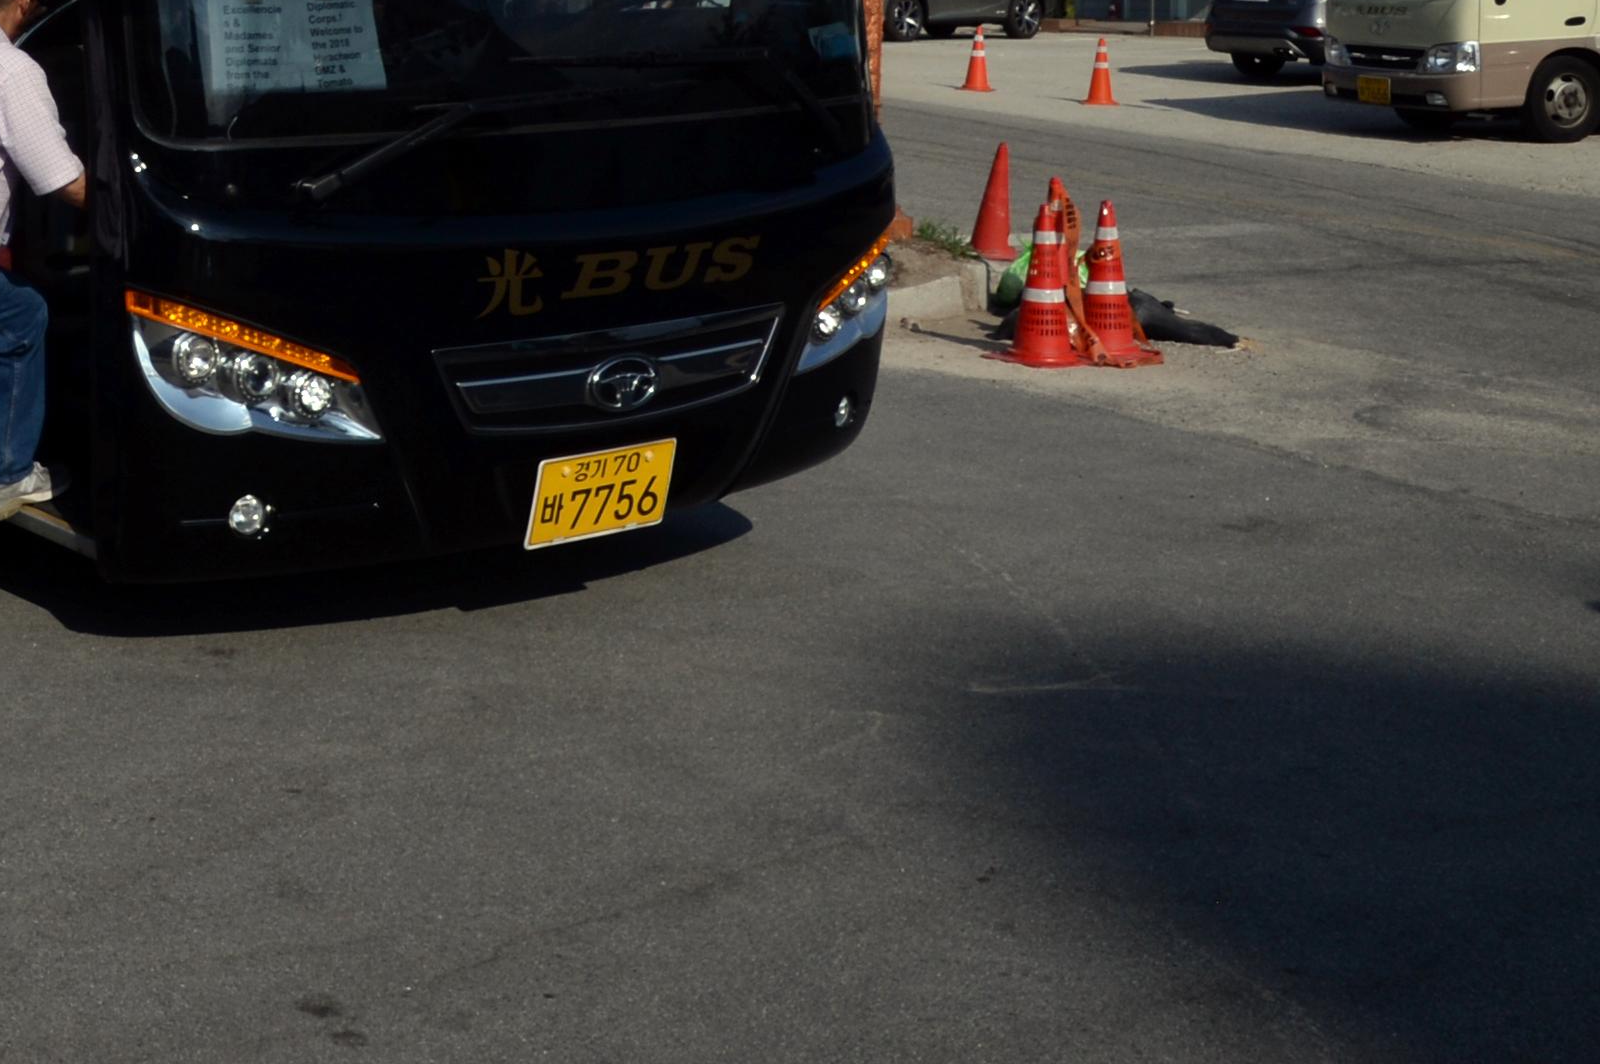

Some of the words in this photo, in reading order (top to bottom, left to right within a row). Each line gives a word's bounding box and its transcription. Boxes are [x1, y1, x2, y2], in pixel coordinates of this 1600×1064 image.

[309, 27, 352, 37] Welcome
[353, 25, 364, 34] to
[311, 40, 327, 49] the
[474, 247, 545, 320] 光
[558, 234, 763, 302] BUS
[574, 458, 608, 483] 경기
[613, 451, 641, 476] 70
